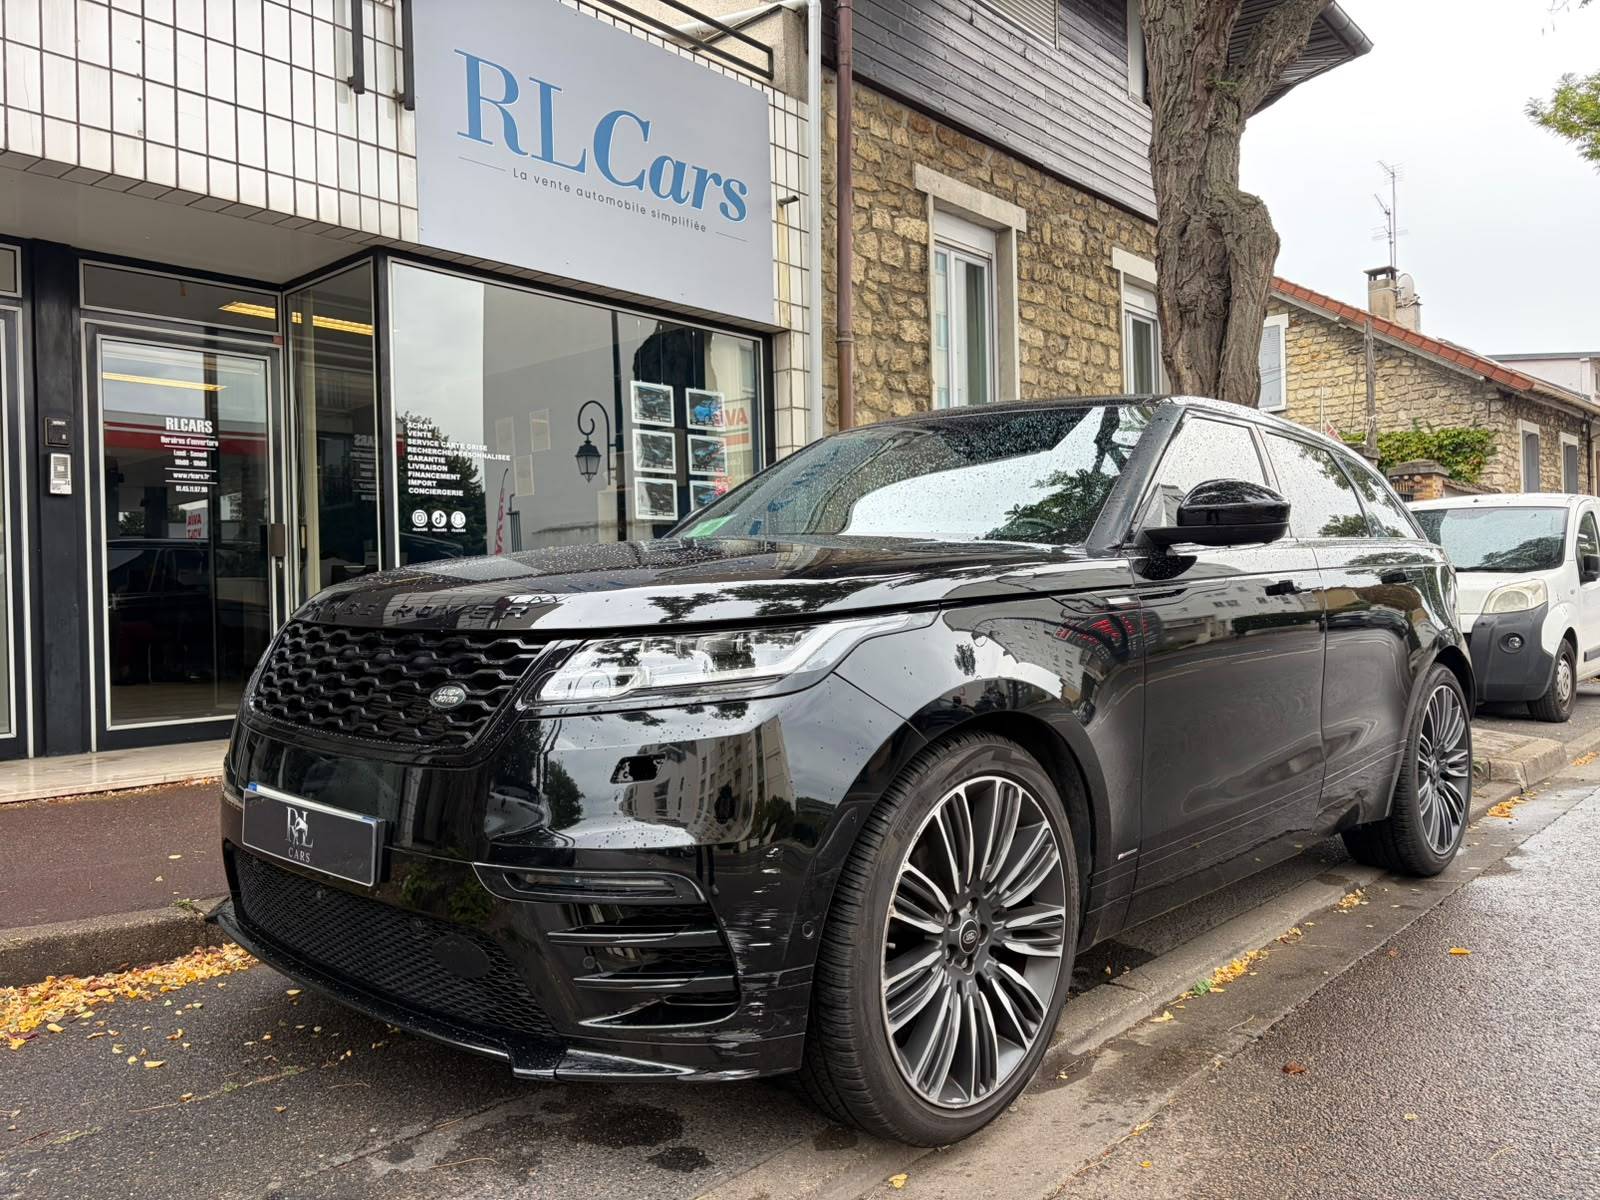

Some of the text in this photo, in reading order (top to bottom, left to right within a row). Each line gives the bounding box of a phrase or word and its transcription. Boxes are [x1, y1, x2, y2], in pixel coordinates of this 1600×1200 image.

[513, 167, 528, 181] La
[533, 175, 571, 193] vente
[576, 187, 646, 215] automobile
[165, 417, 213, 433] RLCARS
[407, 422, 432, 430] ACHAT
[407, 430, 433, 438] VENTE
[407, 438, 488, 451] SERVICE CARTE GRISE
[407, 446, 452, 456] RECHERCHE
[407, 454, 446, 463] GARANTIE
[407, 463, 448, 472] LIVRAISON
[407, 471, 461, 480] FINANCEMENT
[408, 479, 437, 487] IMPORT
[408, 487, 464, 497] CONCIERGERIE
[288, 846, 311, 863] CARS
